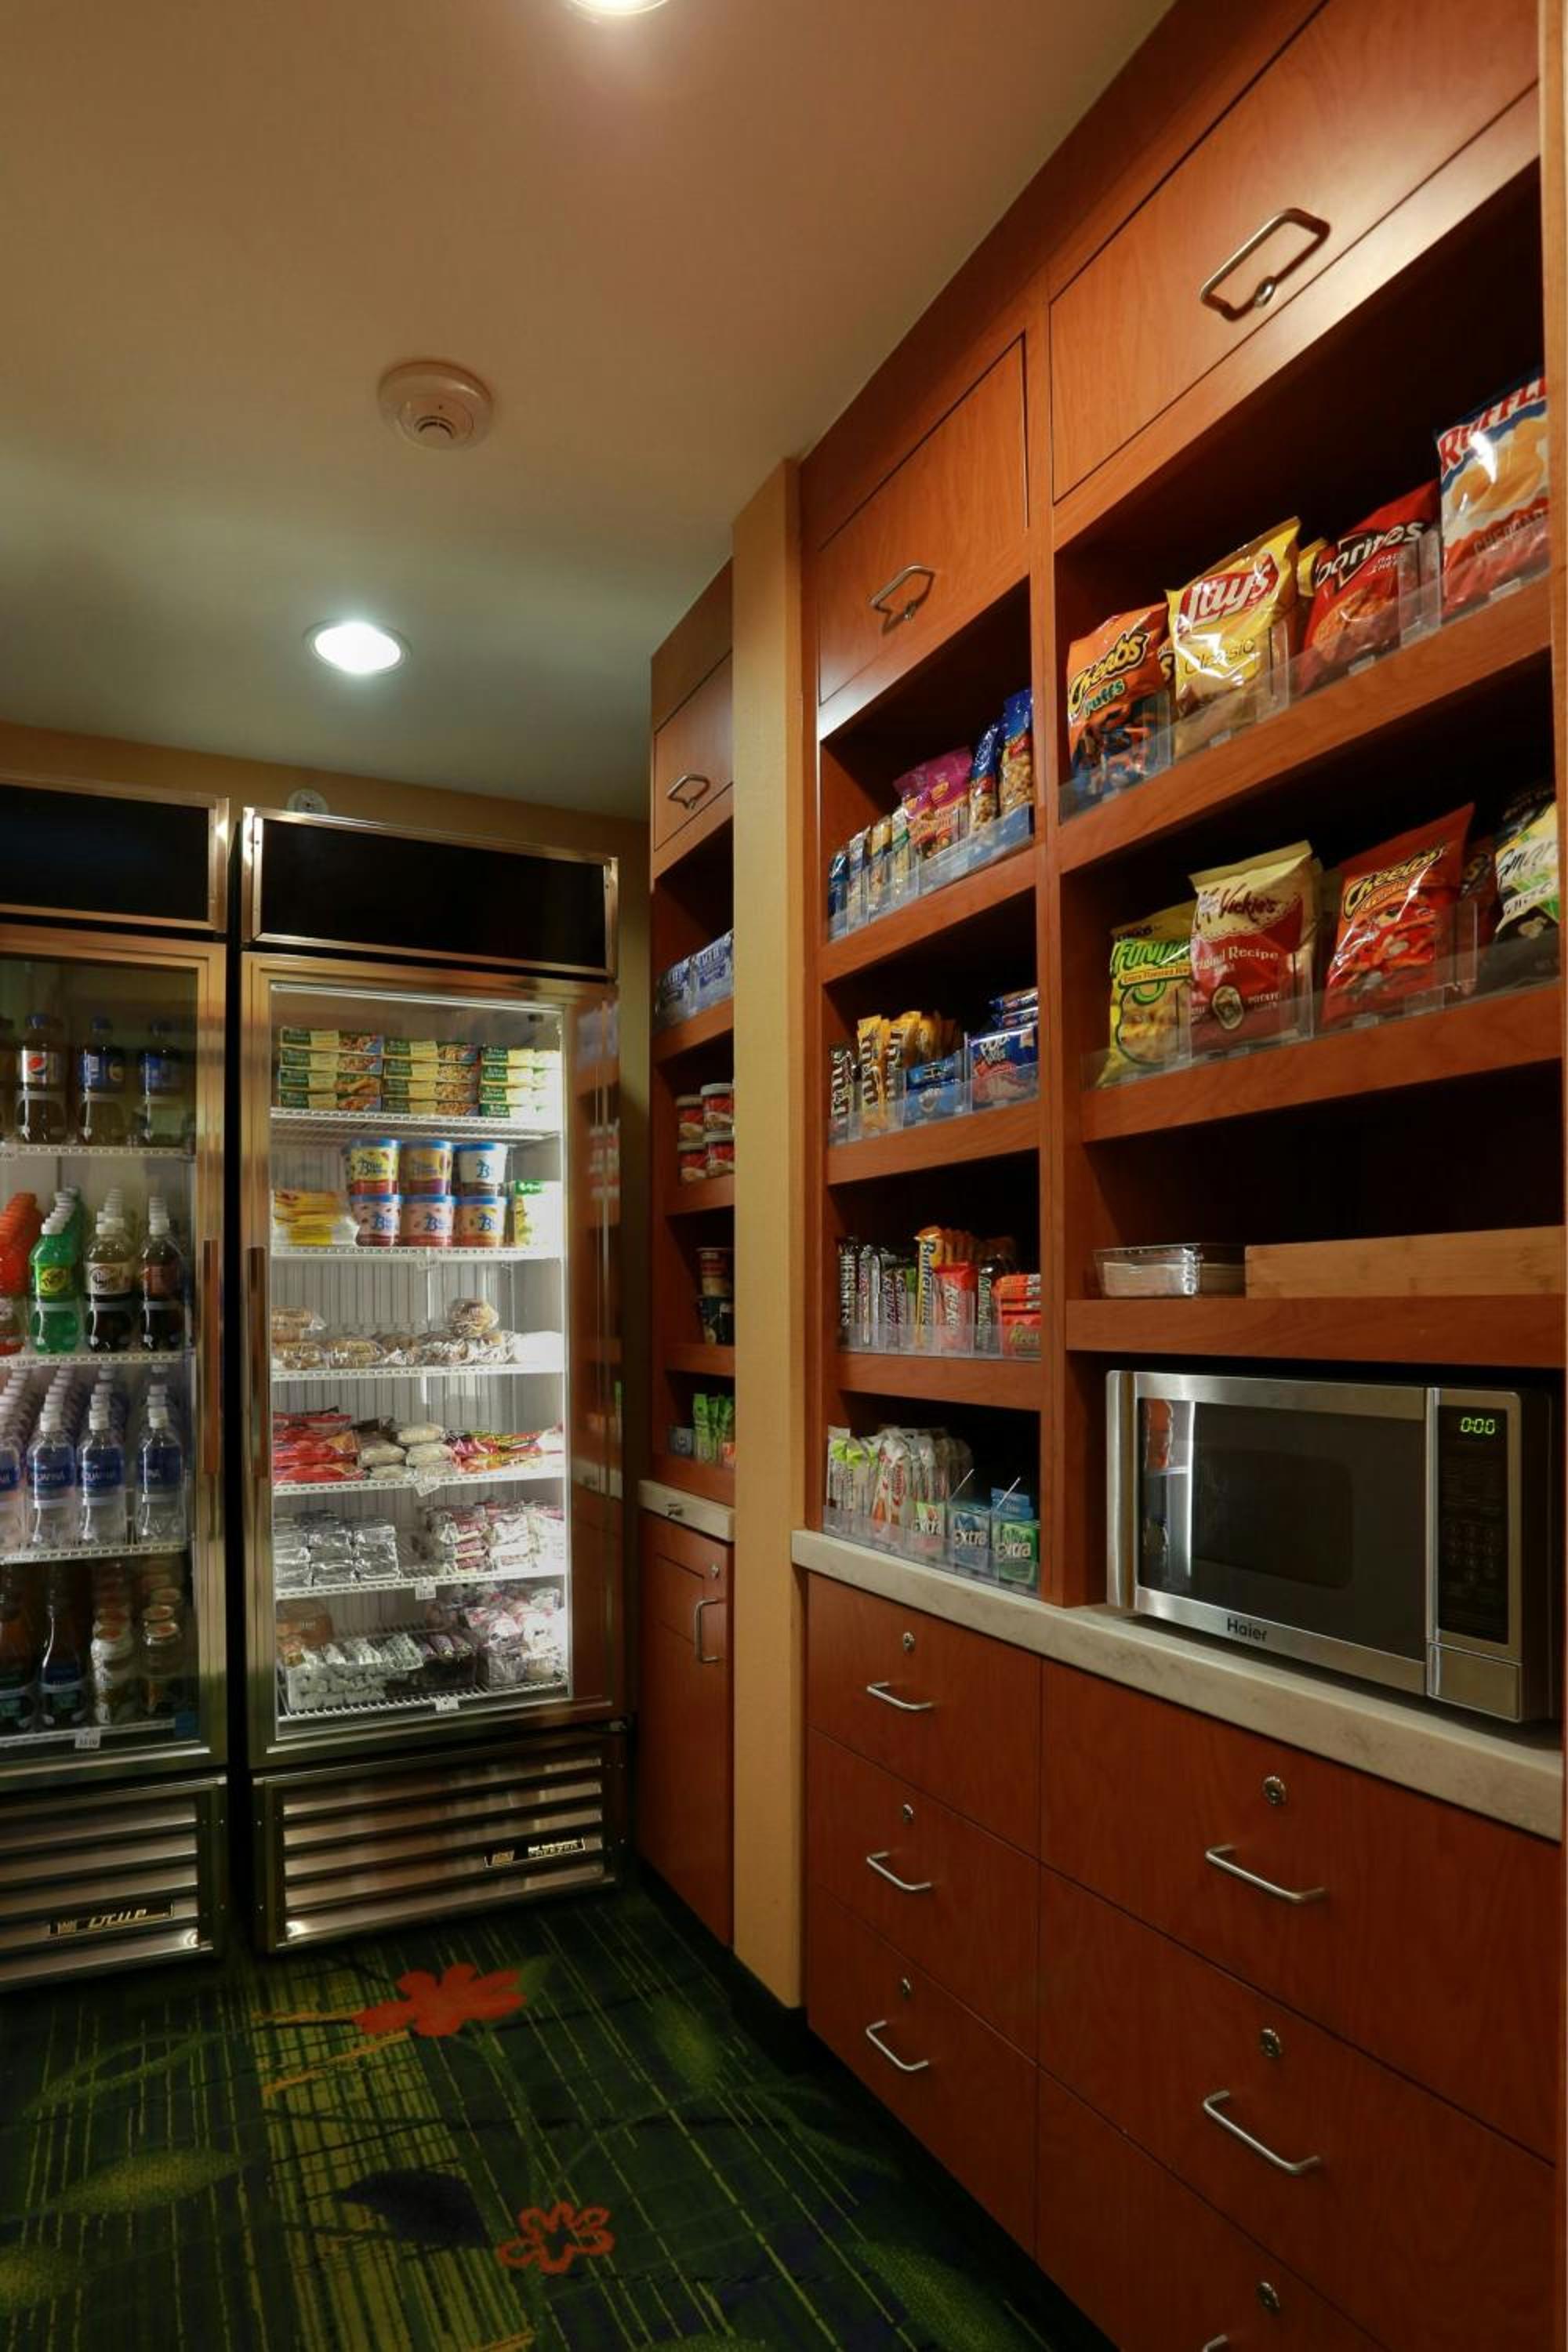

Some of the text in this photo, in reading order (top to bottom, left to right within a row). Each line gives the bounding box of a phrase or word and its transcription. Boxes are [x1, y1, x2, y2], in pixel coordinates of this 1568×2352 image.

[1438, 376, 1547, 477] RUFFL
[1316, 521, 1425, 588] Doritos
[1187, 562, 1272, 629] Lay's
[1229, 946, 1279, 960] Recipe
[1461, 1417, 1495, 1436] 0:00
[1227, 1617, 1268, 1642] Haier
